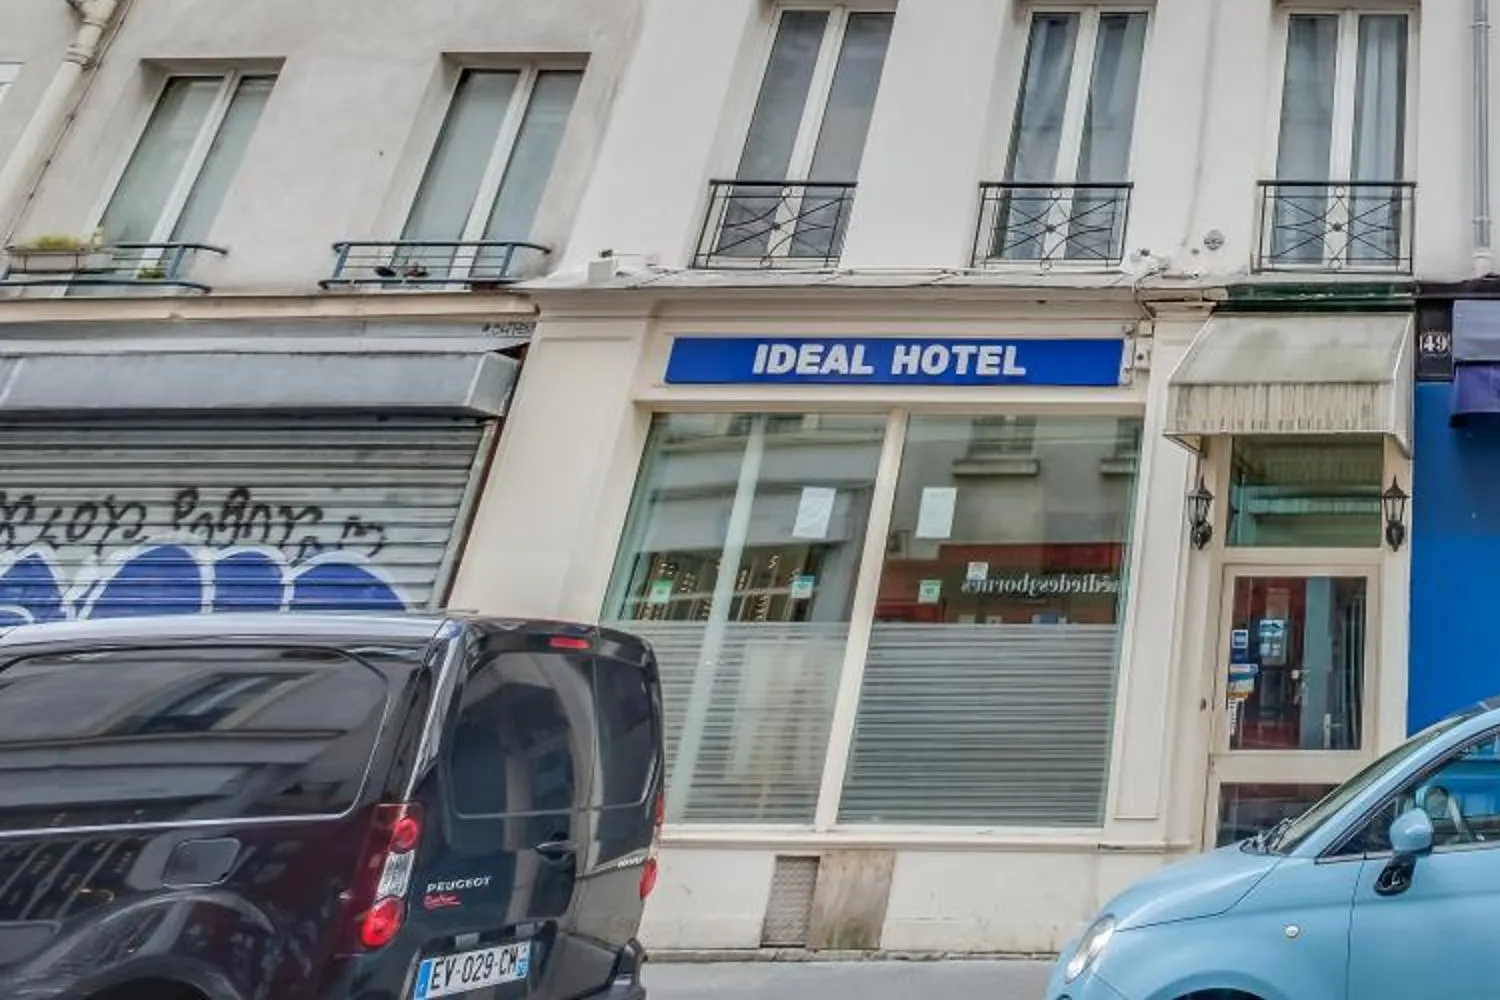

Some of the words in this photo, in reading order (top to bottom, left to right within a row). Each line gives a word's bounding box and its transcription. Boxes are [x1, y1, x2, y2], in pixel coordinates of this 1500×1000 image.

[1423, 335, 1447, 351] 49
[752, 344, 874, 375] IDEAL
[891, 345, 1026, 376] HOTEL
[426, 876, 492, 893] PEUGEOT
[431, 948, 520, 990] EV-029-CM
